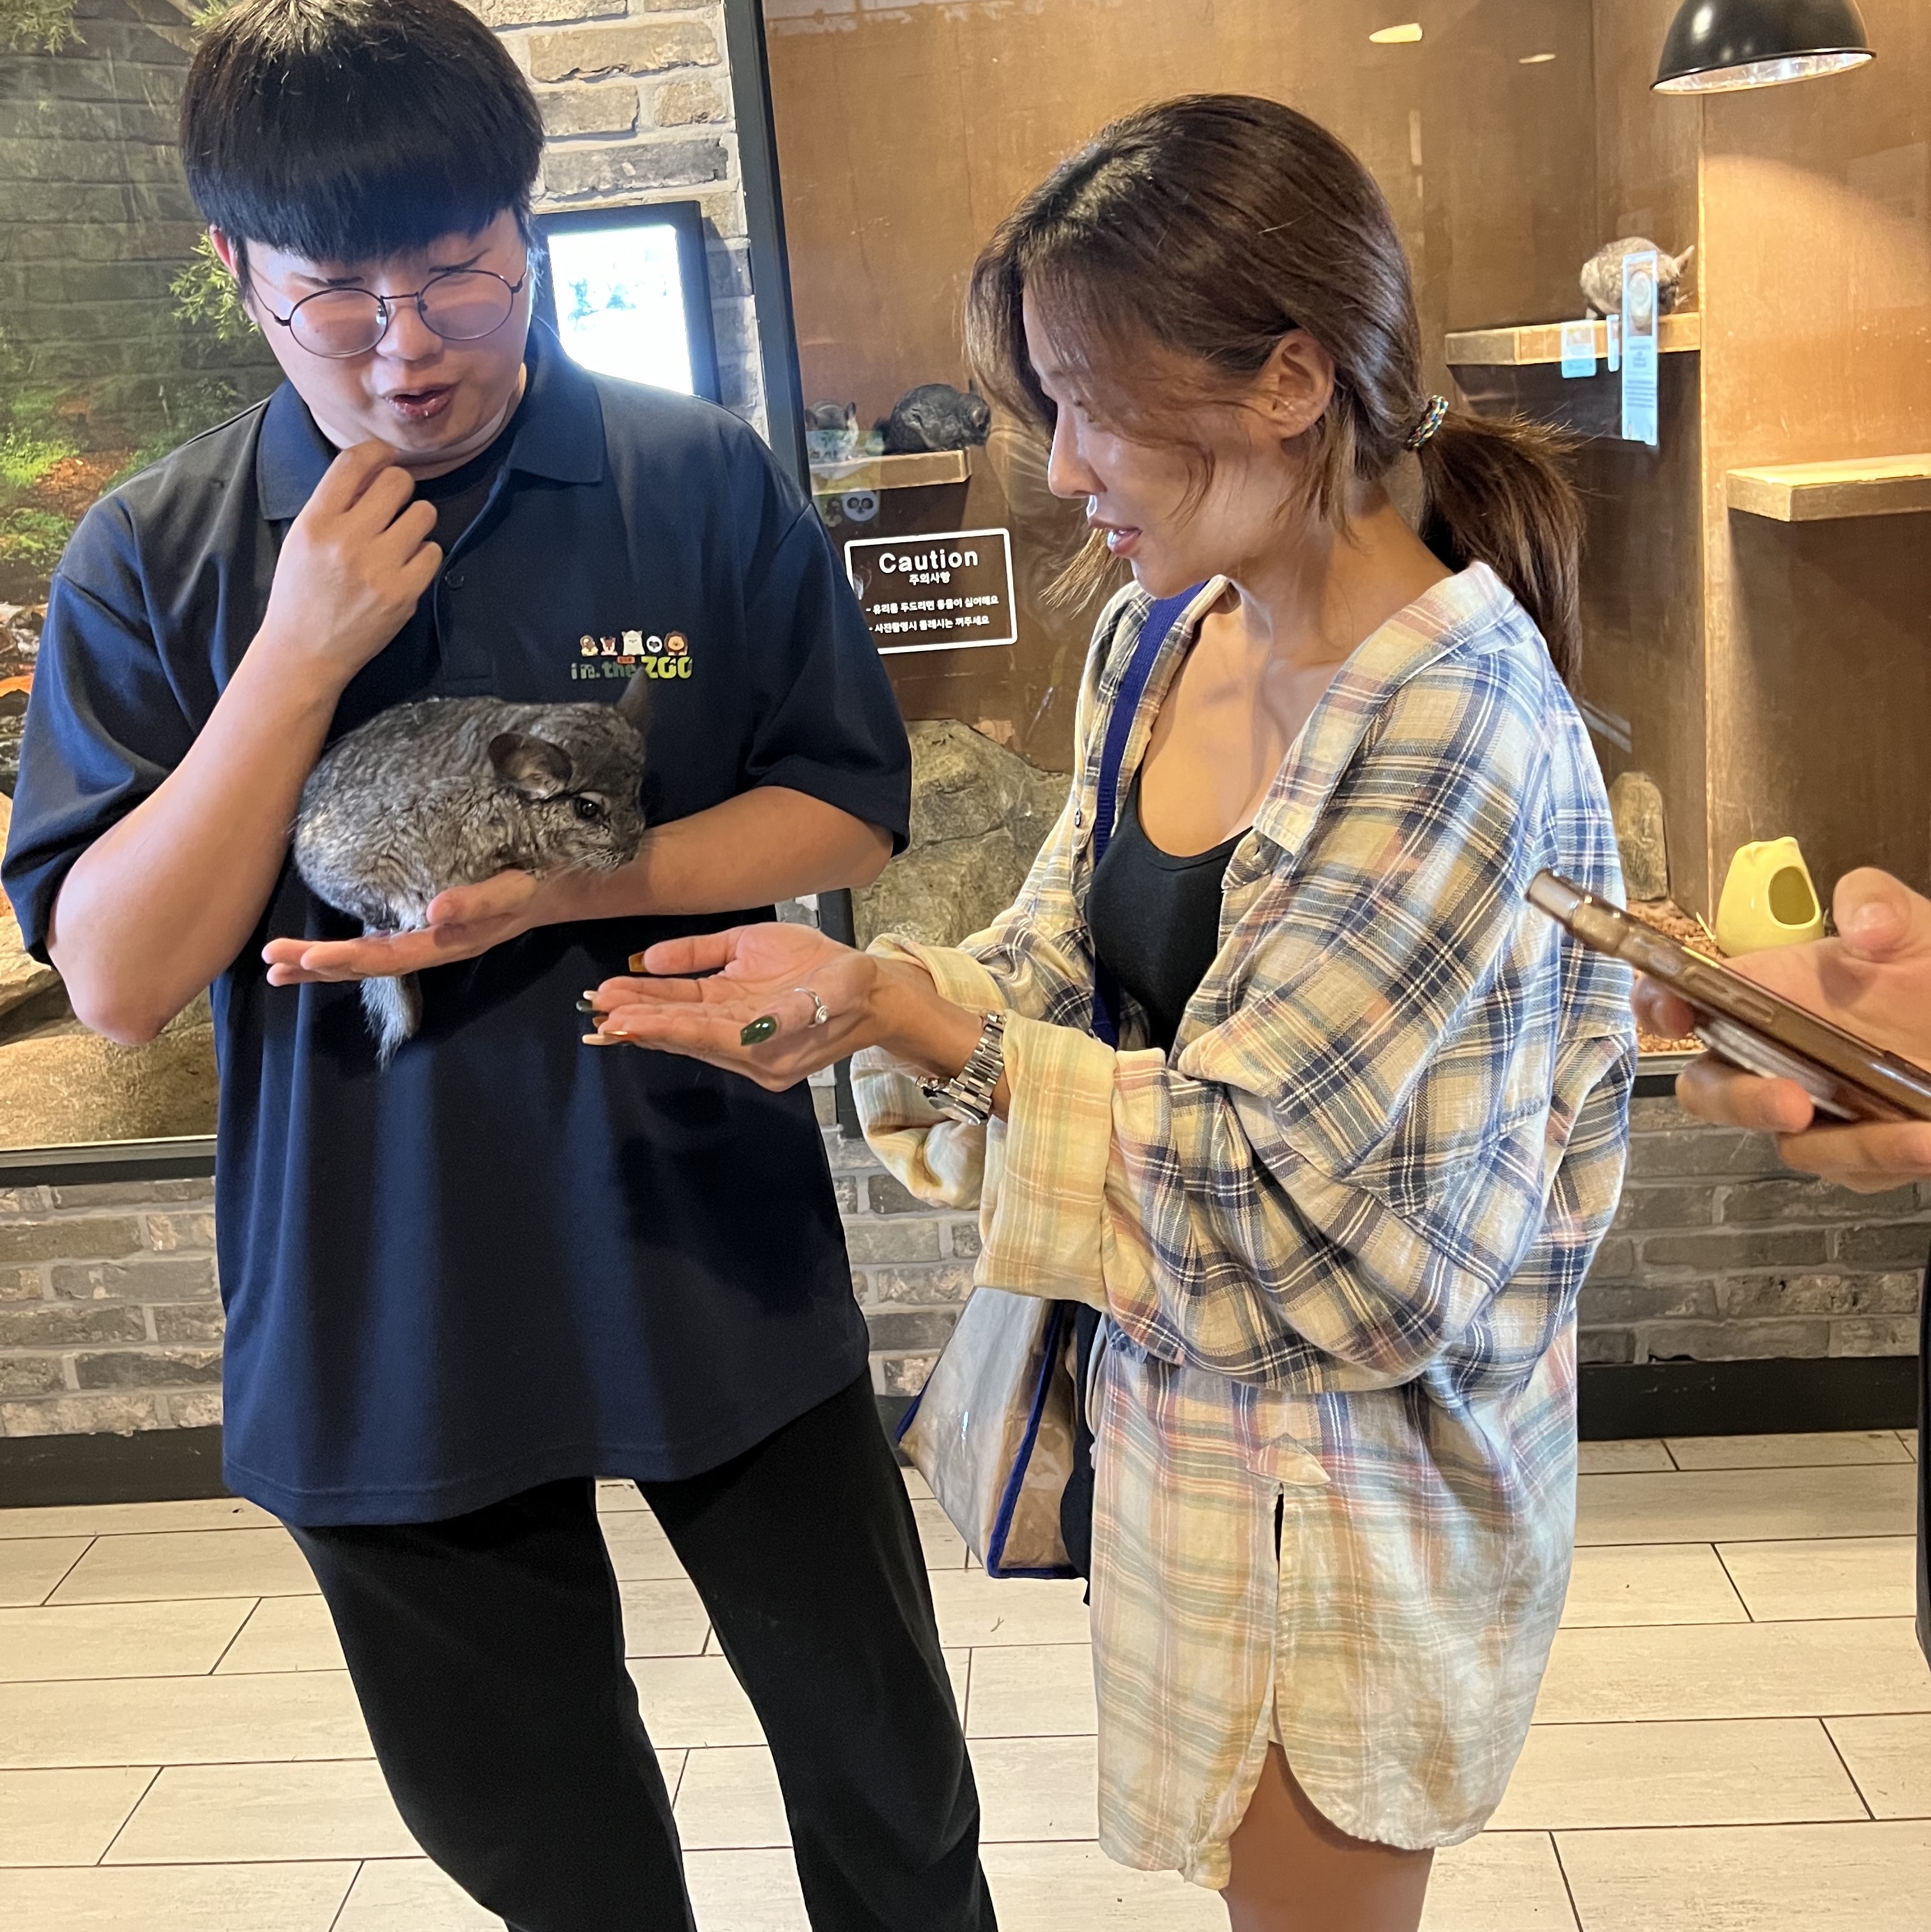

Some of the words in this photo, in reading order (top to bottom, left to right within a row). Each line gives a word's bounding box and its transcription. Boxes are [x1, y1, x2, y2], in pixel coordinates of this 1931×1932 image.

[878, 549, 978, 574] Caution
[908, 571, 950, 586] 주의사항
[900, 600, 935, 612] 두드리면
[641, 655, 692, 679] ZOO
